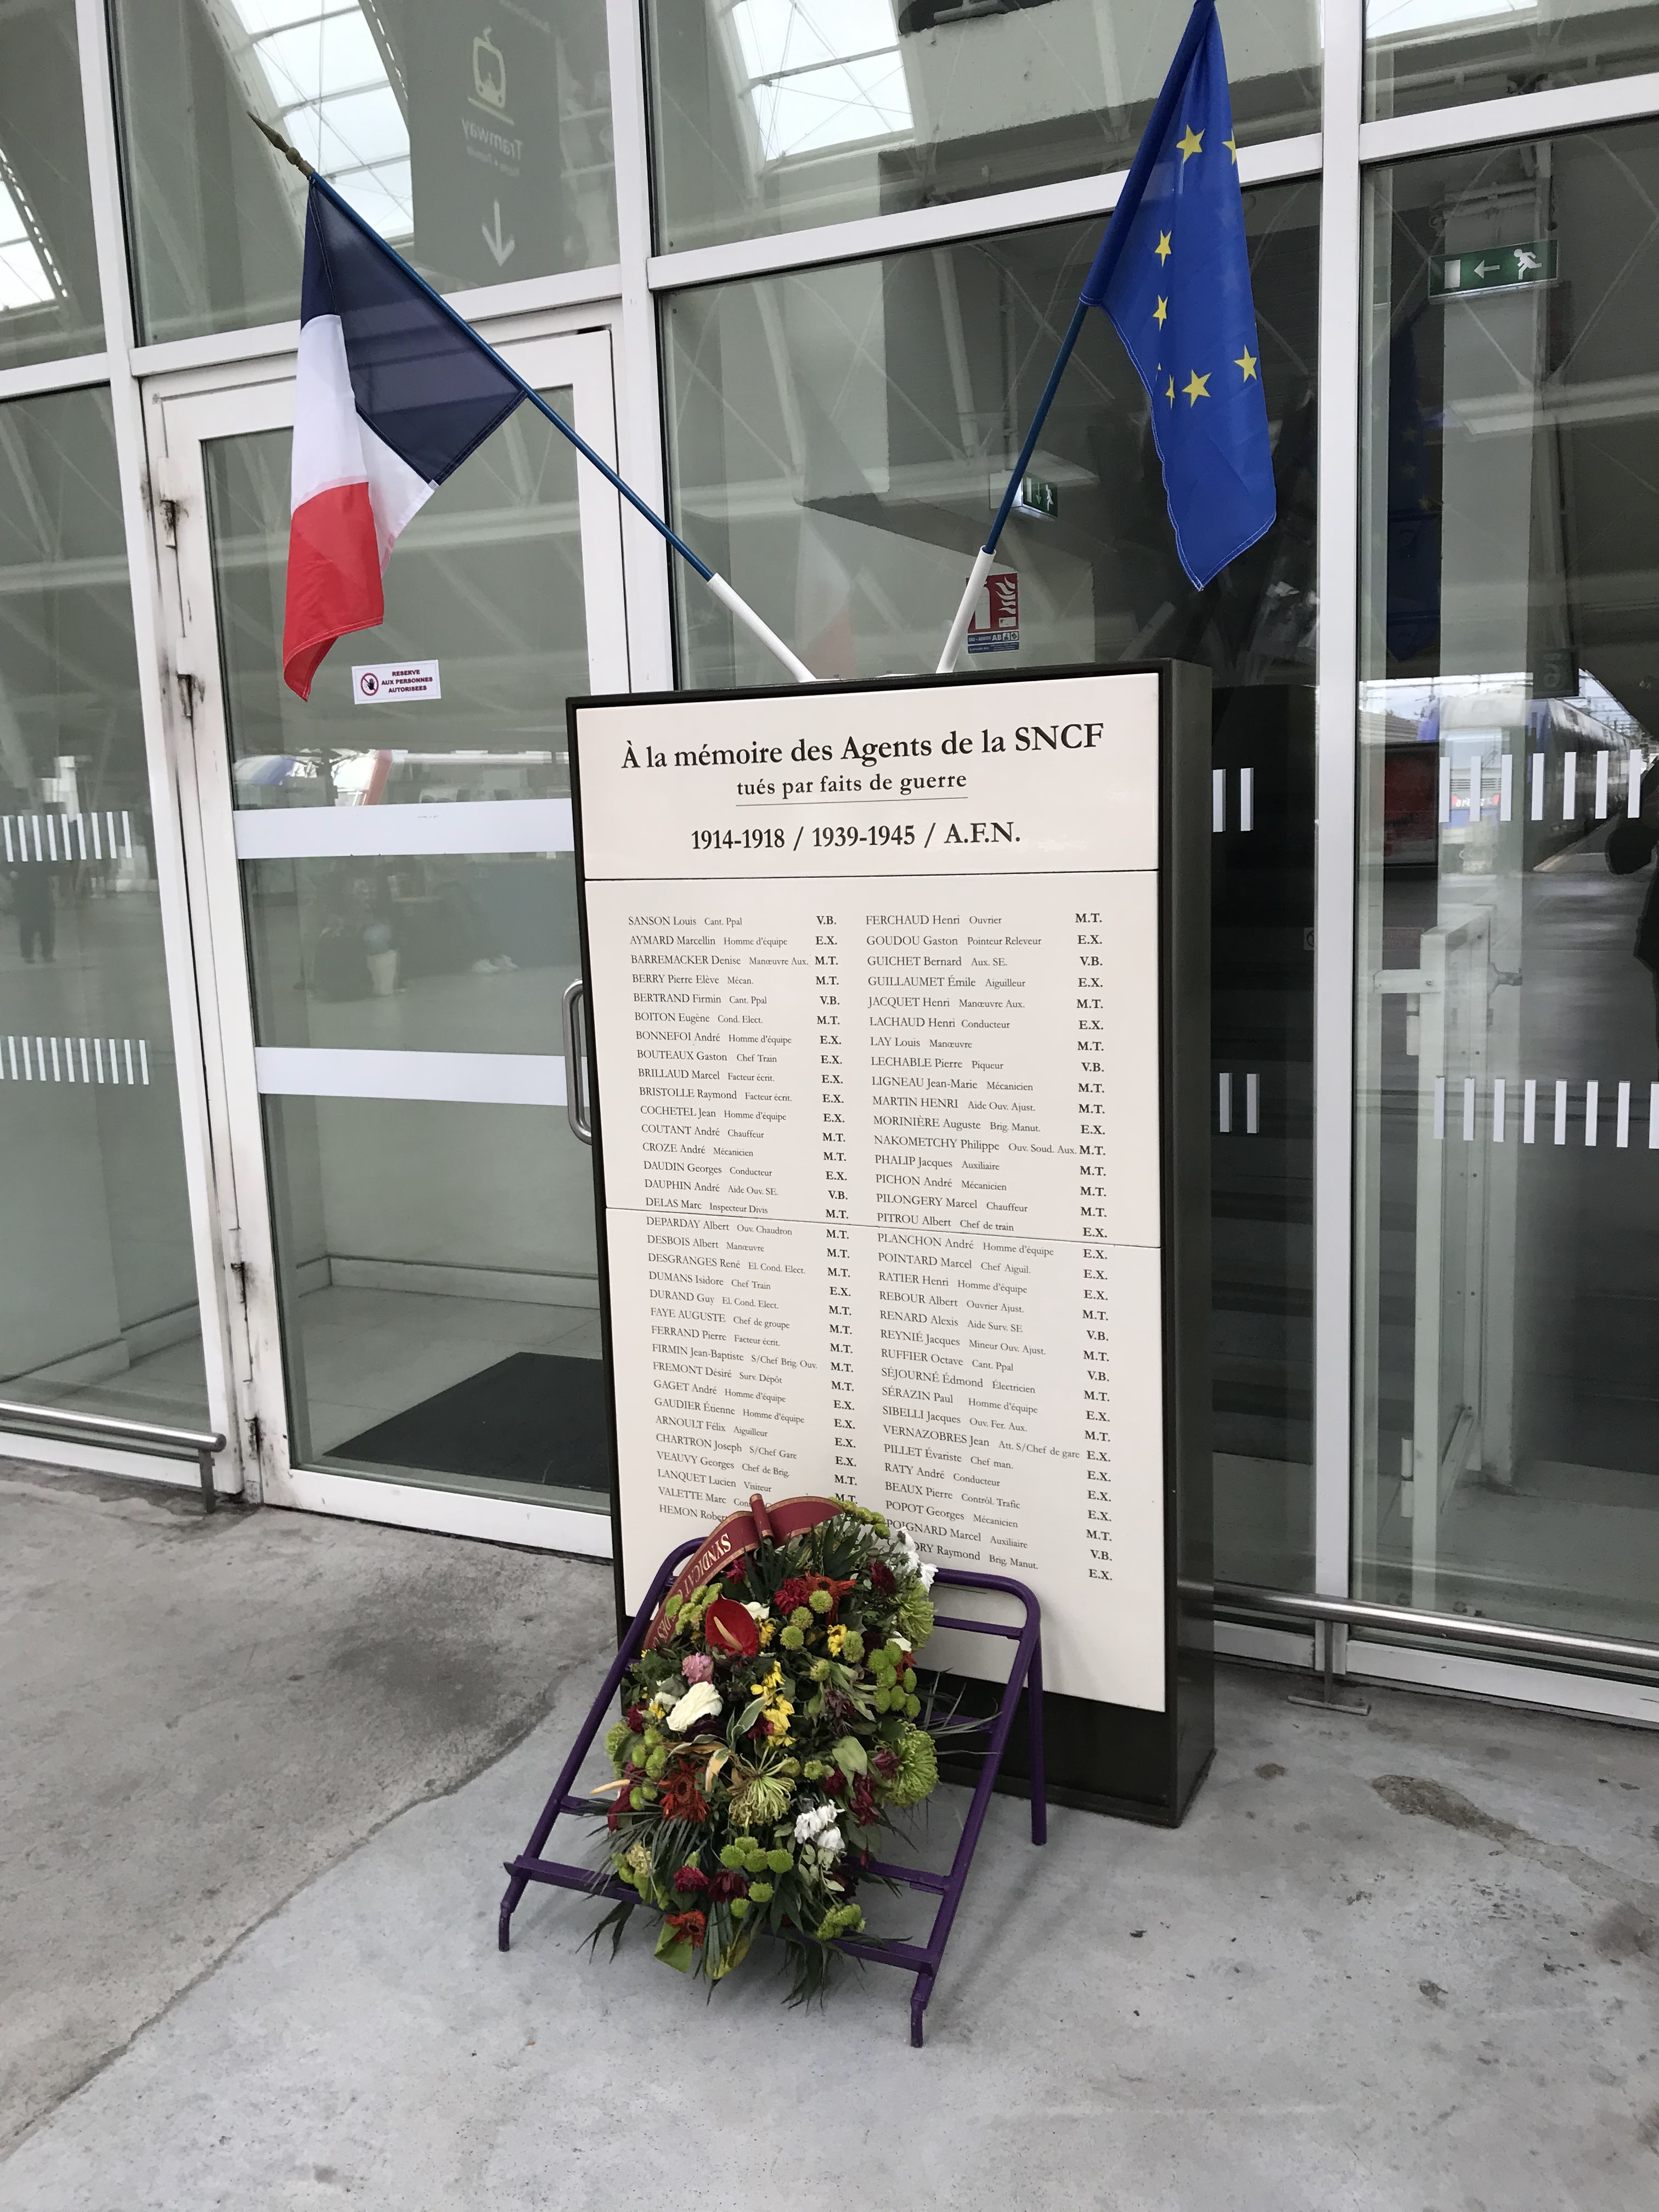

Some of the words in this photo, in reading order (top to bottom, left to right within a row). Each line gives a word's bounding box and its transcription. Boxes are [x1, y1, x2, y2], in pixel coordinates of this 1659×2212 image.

[622, 741, 640, 768] À
[646, 746, 667, 768] la
[674, 741, 782, 766] mémoire
[791, 738, 832, 761] des
[840, 736, 932, 766] Agents
[942, 731, 973, 754] de
[982, 729, 1006, 753] la
[1015, 723, 1103, 751] SNCF
[737, 779, 775, 794] tués
[782, 782, 813, 799] par
[821, 775, 861, 792] faits
[870, 774, 892, 790] de
[900, 776, 966, 795] guerre
[692, 829, 785, 849] 1914-1918
[793, 827, 804, 851] /
[812, 825, 915, 847] 1939-1945
[924, 823, 936, 848] /
[944, 822, 1020, 843] A.F.N.
[628, 916, 670, 926] SANSON
[673, 916, 697, 926] Louis
[704, 917, 724, 926] Cant.
[726, 917, 742, 928] Ppal
[815, 915, 837, 925] V.B.
[866, 935, 920, 946] GOUDOU
[923, 935, 958, 945] Gaston
[967, 936, 1003, 945] Pointeur
[1005, 936, 1042, 945] Releveur
[1077, 934, 1103, 945] E.X.
[630, 955, 709, 964] BARREMACKER
[710, 955, 741, 965] Denise
[791, 957, 809, 966] Aux.
[814, 956, 839, 966] M.T.
[631, 974, 665, 983] BERRY
[667, 974, 693, 984] Pierre
[727, 976, 754, 985] Mécan.
[815, 975, 839, 985] M.T.
[868, 976, 945, 987] GUILLAUMET
[947, 974, 976, 987] Émile
[984, 978, 1026, 990] Aiguilleur
[1077, 977, 1103, 988] E.X.
[633, 992, 690, 1003] BERTRAND
[692, 994, 721, 1003] Firmin
[729, 995, 749, 1004] Cant.
[751, 996, 768, 1007] Ppal
[819, 995, 840, 1006] V.B.
[634, 1012, 676, 1022] BOITON
[678, 1013, 710, 1025] Eugène
[718, 1014, 740, 1023] Cond.
[742, 1015, 763, 1024] Elect.
[816, 1015, 840, 1025] M.T.
[870, 1036, 892, 1046] LAY
[894, 1037, 921, 1047] Louis
[1077, 1041, 1104, 1051] M.T.
[636, 1049, 695, 1060] BOUTEAUX
[696, 1051, 727, 1061] Gaston
[736, 1053, 755, 1062] Chef
[757, 1054, 777, 1063] Train
[820, 1054, 843, 1065] E.X.
[639, 1086, 695, 1098] BRISTOLLE
[697, 1088, 737, 1101] Raymond
[744, 1092, 772, 1101] Facteur
[774, 1093, 792, 1102] écrit.
[822, 1093, 844, 1104] E.X.
[871, 1076, 924, 1087] LIGNEAU
[926, 1077, 978, 1091] Jean-Marie
[986, 1081, 1034, 1091] Mécanicien
[1077, 1082, 1105, 1093] M.T.
[641, 1124, 692, 1135] COUTANT
[694, 1126, 720, 1136] André
[727, 1129, 765, 1138] Chauffeur
[822, 1132, 846, 1142] M.T.
[943, 1118, 981, 1132] Auguste
[990, 1121, 1009, 1133] Brig.
[1011, 1122, 1041, 1132] Manut.
[1080, 1124, 1105, 1135] E.X.
[643, 1160, 685, 1171] DAUDIN
[687, 1163, 723, 1176] Georges
[729, 1166, 773, 1177] Conducteur
[825, 1171, 848, 1181] E.X.
[645, 1197, 679, 1208] DELAS
[680, 1199, 702, 1210] Marc
[709, 1202, 747, 1214] Inspecteur
[748, 1205, 768, 1214] Divis
[825, 1209, 849, 1220] M.T.
[876, 1193, 943, 1206] PILONGERY
[945, 1198, 978, 1209] Marcel
[986, 1201, 1028, 1212] Chauffeur
[1080, 1206, 1107, 1217] M.T.
[646, 1216, 701, 1229] DEPARDAY
[703, 1220, 730, 1231] Albert
[737, 1224, 754, 1233] Ouv.
[755, 1225, 793, 1235] Chaudron
[826, 1229, 849, 1239] M.T.
[878, 1252, 938, 1266] POINTARD
[940, 1257, 973, 1269] Marcel
[980, 1262, 1002, 1271] Chef
[1004, 1263, 1031, 1276] Aiguil.
[1083, 1268, 1108, 1280] E.X.
[648, 1271, 693, 1283] DUMANS
[695, 1274, 724, 1286] Isidore
[731, 1279, 750, 1288] Chef
[751, 1280, 771, 1290] Train
[829, 1286, 851, 1297] E.X.
[879, 1290, 926, 1304] REBOUR
[928, 1295, 958, 1307] Albert
[966, 1300, 998, 1311] Ouvrier
[1000, 1303, 1024, 1314] Ajust.
[1082, 1309, 1109, 1321] M.T.
[652, 1361, 703, 1375] FREMONT
[705, 1367, 732, 1378] Désiré
[739, 1371, 757, 1381] Surv.
[759, 1373, 782, 1385] Dépôt
[831, 1380, 854, 1392] M.T.
[881, 1348, 929, 1362] RUFFIER
[930, 1353, 963, 1366] Octave
[972, 1359, 994, 1369] Cant.
[995, 1361, 1014, 1373] Ppal
[1086, 1370, 1110, 1382] V.B.
[655, 1415, 704, 1429] ARNOULT
[706, 1421, 726, 1432] Félix
[733, 1426, 768, 1437] Aiguilleur
[834, 1437, 856, 1448] E.X.
[656, 1433, 712, 1448] CHARTRON
[713, 1440, 742, 1454] Joseph
[749, 1446, 777, 1457] S/Chef
[778, 1449, 797, 1459] Gare
[834, 1455, 857, 1467] E.X.
[883, 1443, 923, 1457] PILLET
[970, 1456, 991, 1466] Chef
[993, 1461, 1013, 1469] man.
[1087, 1470, 1111, 1482] E.X.
[885, 1500, 924, 1514] POPOT
[926, 1506, 965, 1522] Georges
[973, 1514, 1018, 1528] Mécanicien
[1086, 1528, 1113, 1542] M.T.
[685, 1533, 731, 1597] SYNDICAT
